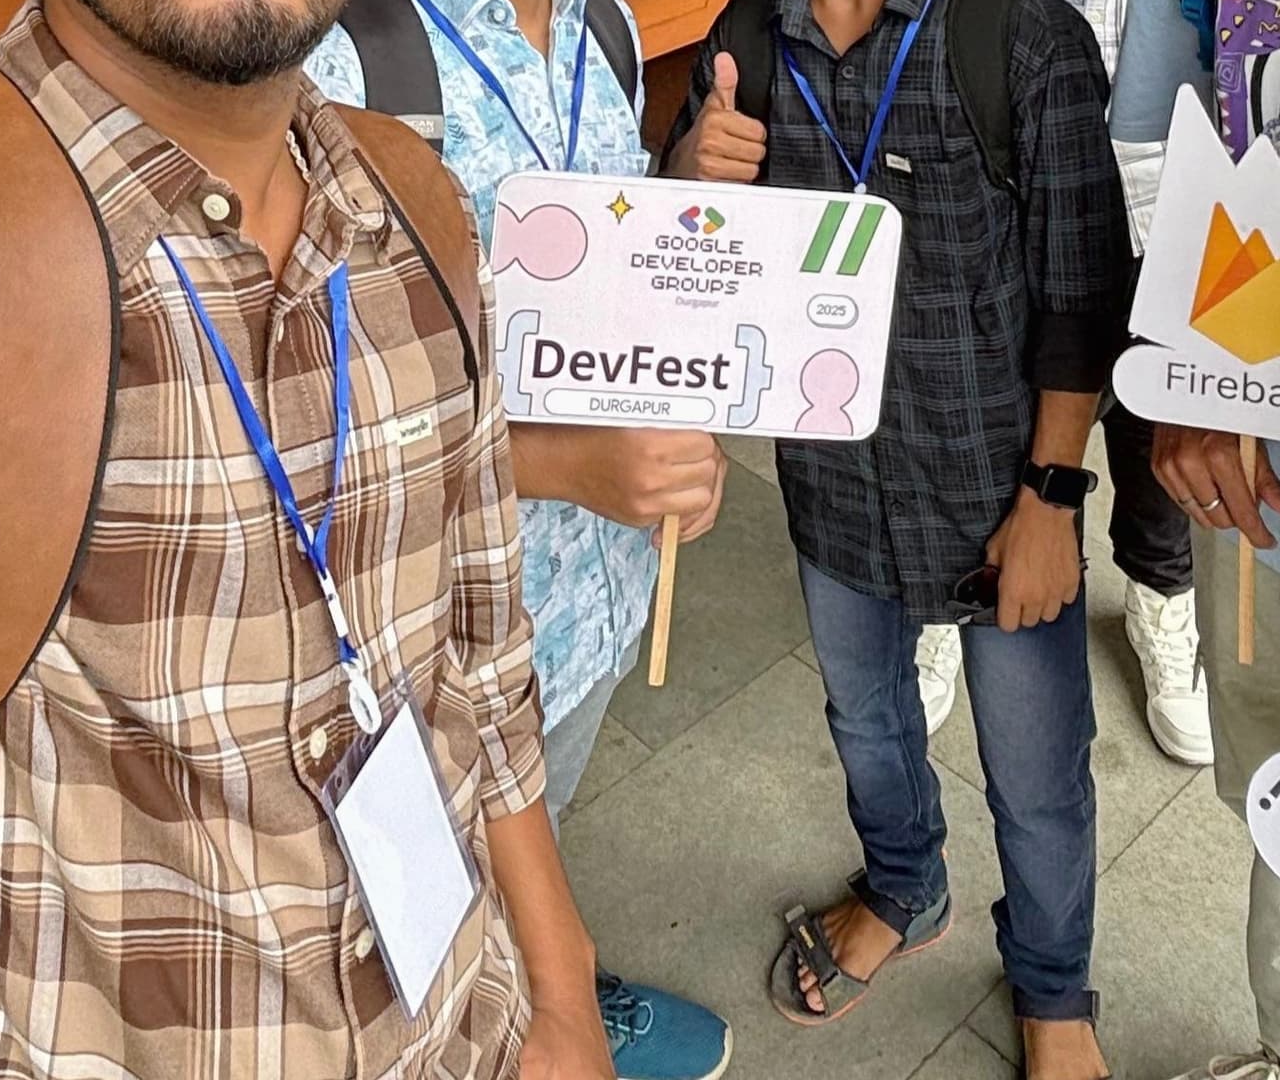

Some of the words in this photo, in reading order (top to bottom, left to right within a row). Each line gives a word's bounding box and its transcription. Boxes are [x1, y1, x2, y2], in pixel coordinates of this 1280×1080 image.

[655, 235, 744, 255] GOOGLE
[630, 253, 763, 277] DEVELOPER
[651, 275, 739, 295] GROUPS
[816, 304, 847, 317] 2025
[532, 339, 730, 390] DevFest
[589, 397, 671, 415] DURGAPUR
